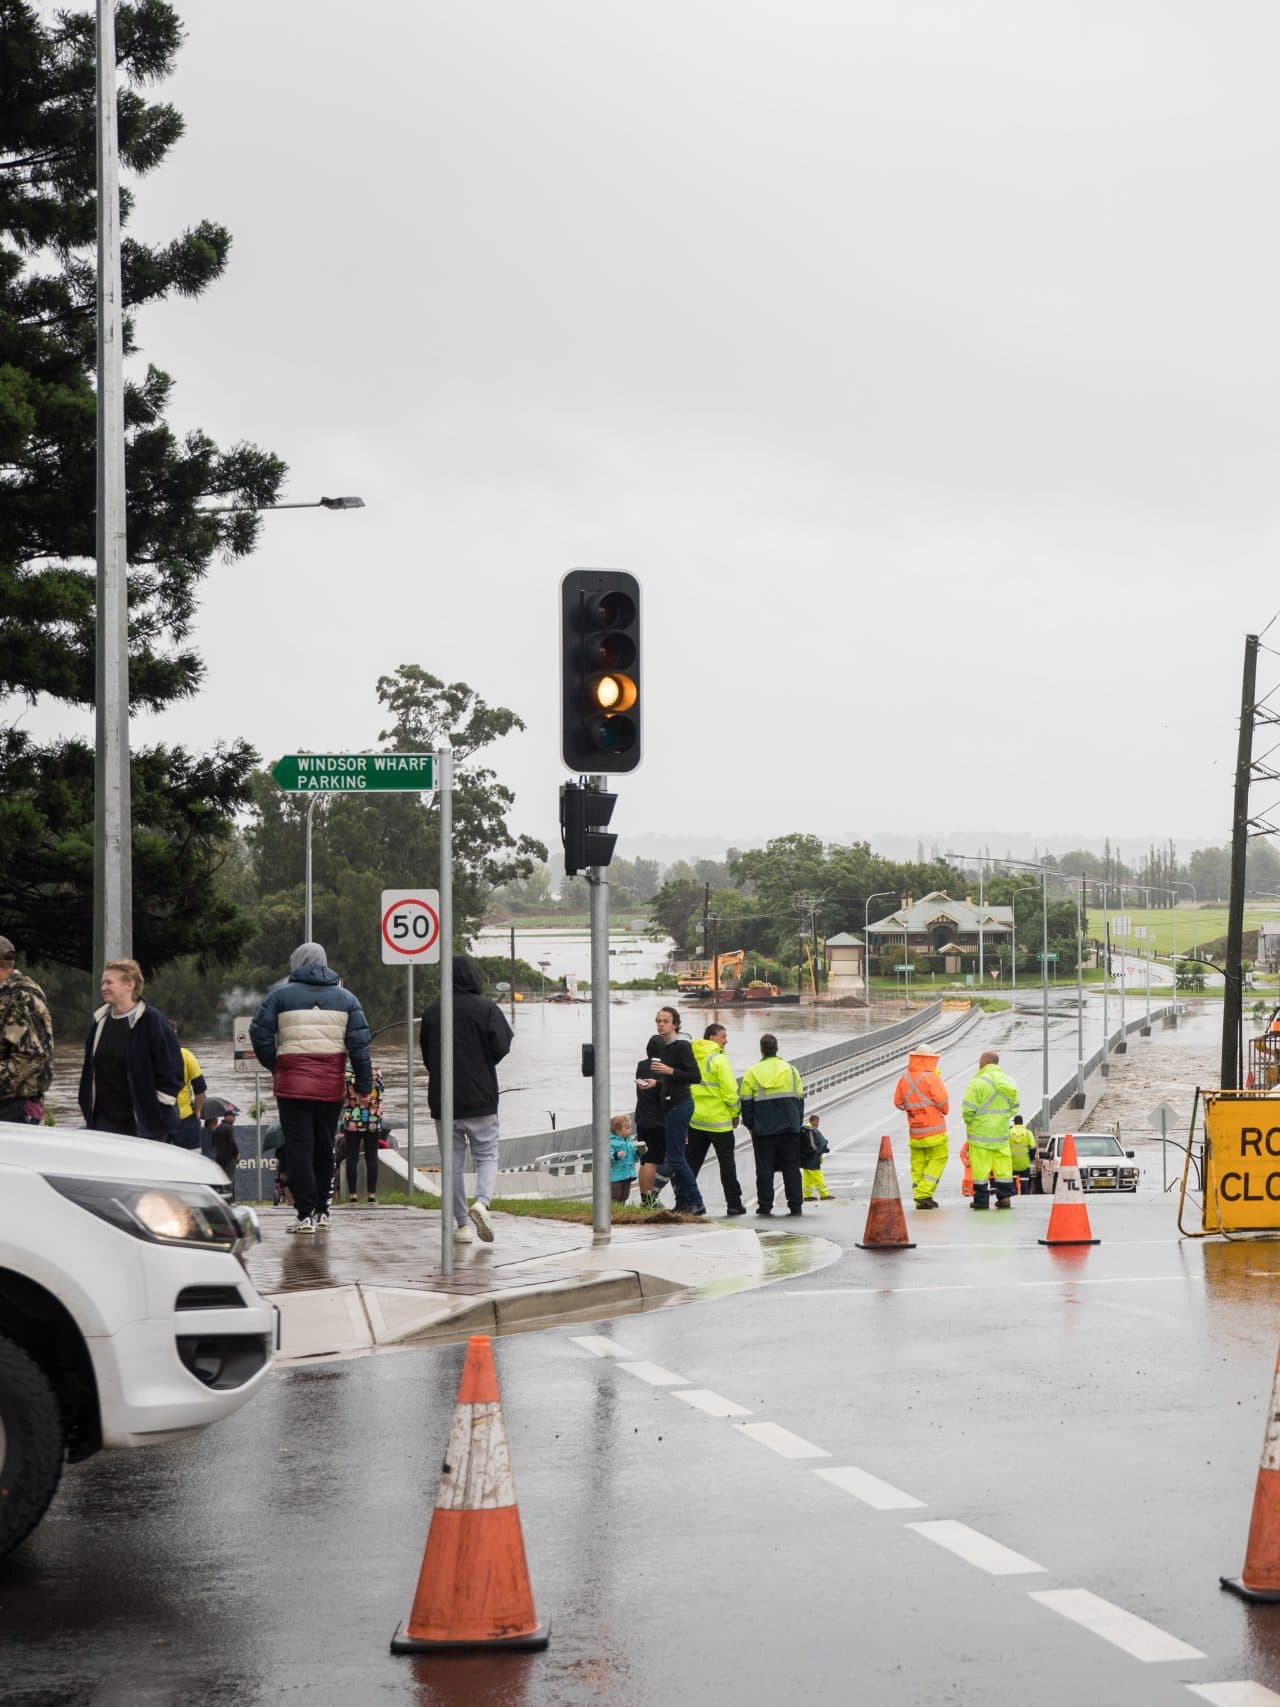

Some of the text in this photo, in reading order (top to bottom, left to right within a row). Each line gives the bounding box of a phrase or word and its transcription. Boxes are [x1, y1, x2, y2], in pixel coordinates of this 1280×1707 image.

[297, 758, 428, 771] WINDSOR WHARF
[297, 775, 367, 789] PARKING
[393, 915, 429, 939] 50
[1063, 1178, 1080, 1191] TL
